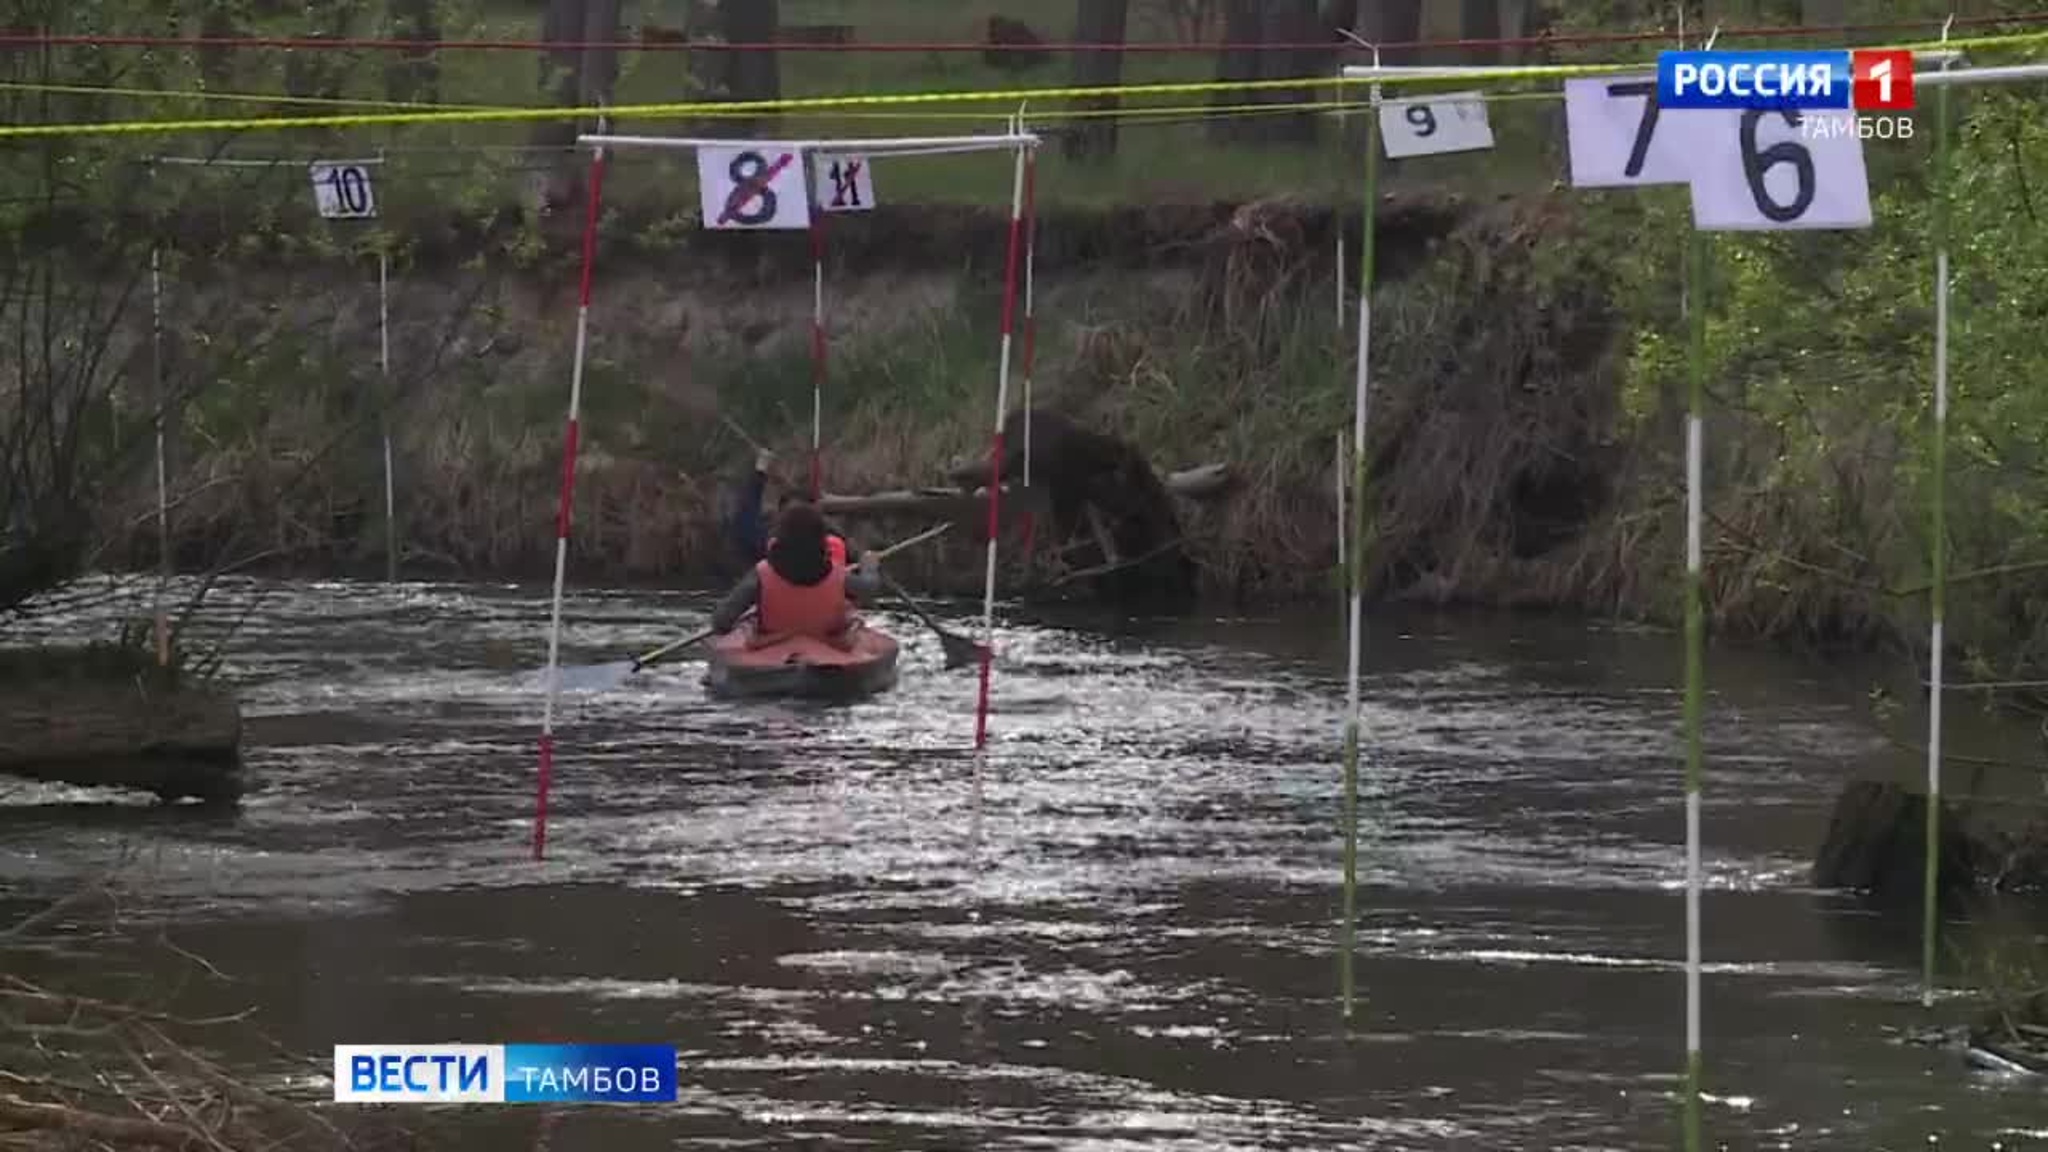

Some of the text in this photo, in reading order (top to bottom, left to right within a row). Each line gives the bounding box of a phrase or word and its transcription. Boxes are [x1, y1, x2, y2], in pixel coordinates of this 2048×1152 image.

[1406, 105, 1437, 138] 9
[1607, 82, 1661, 177] 7
[326, 167, 367, 213] 10
[729, 150, 777, 225] 8
[1740, 109, 1816, 222] 6
